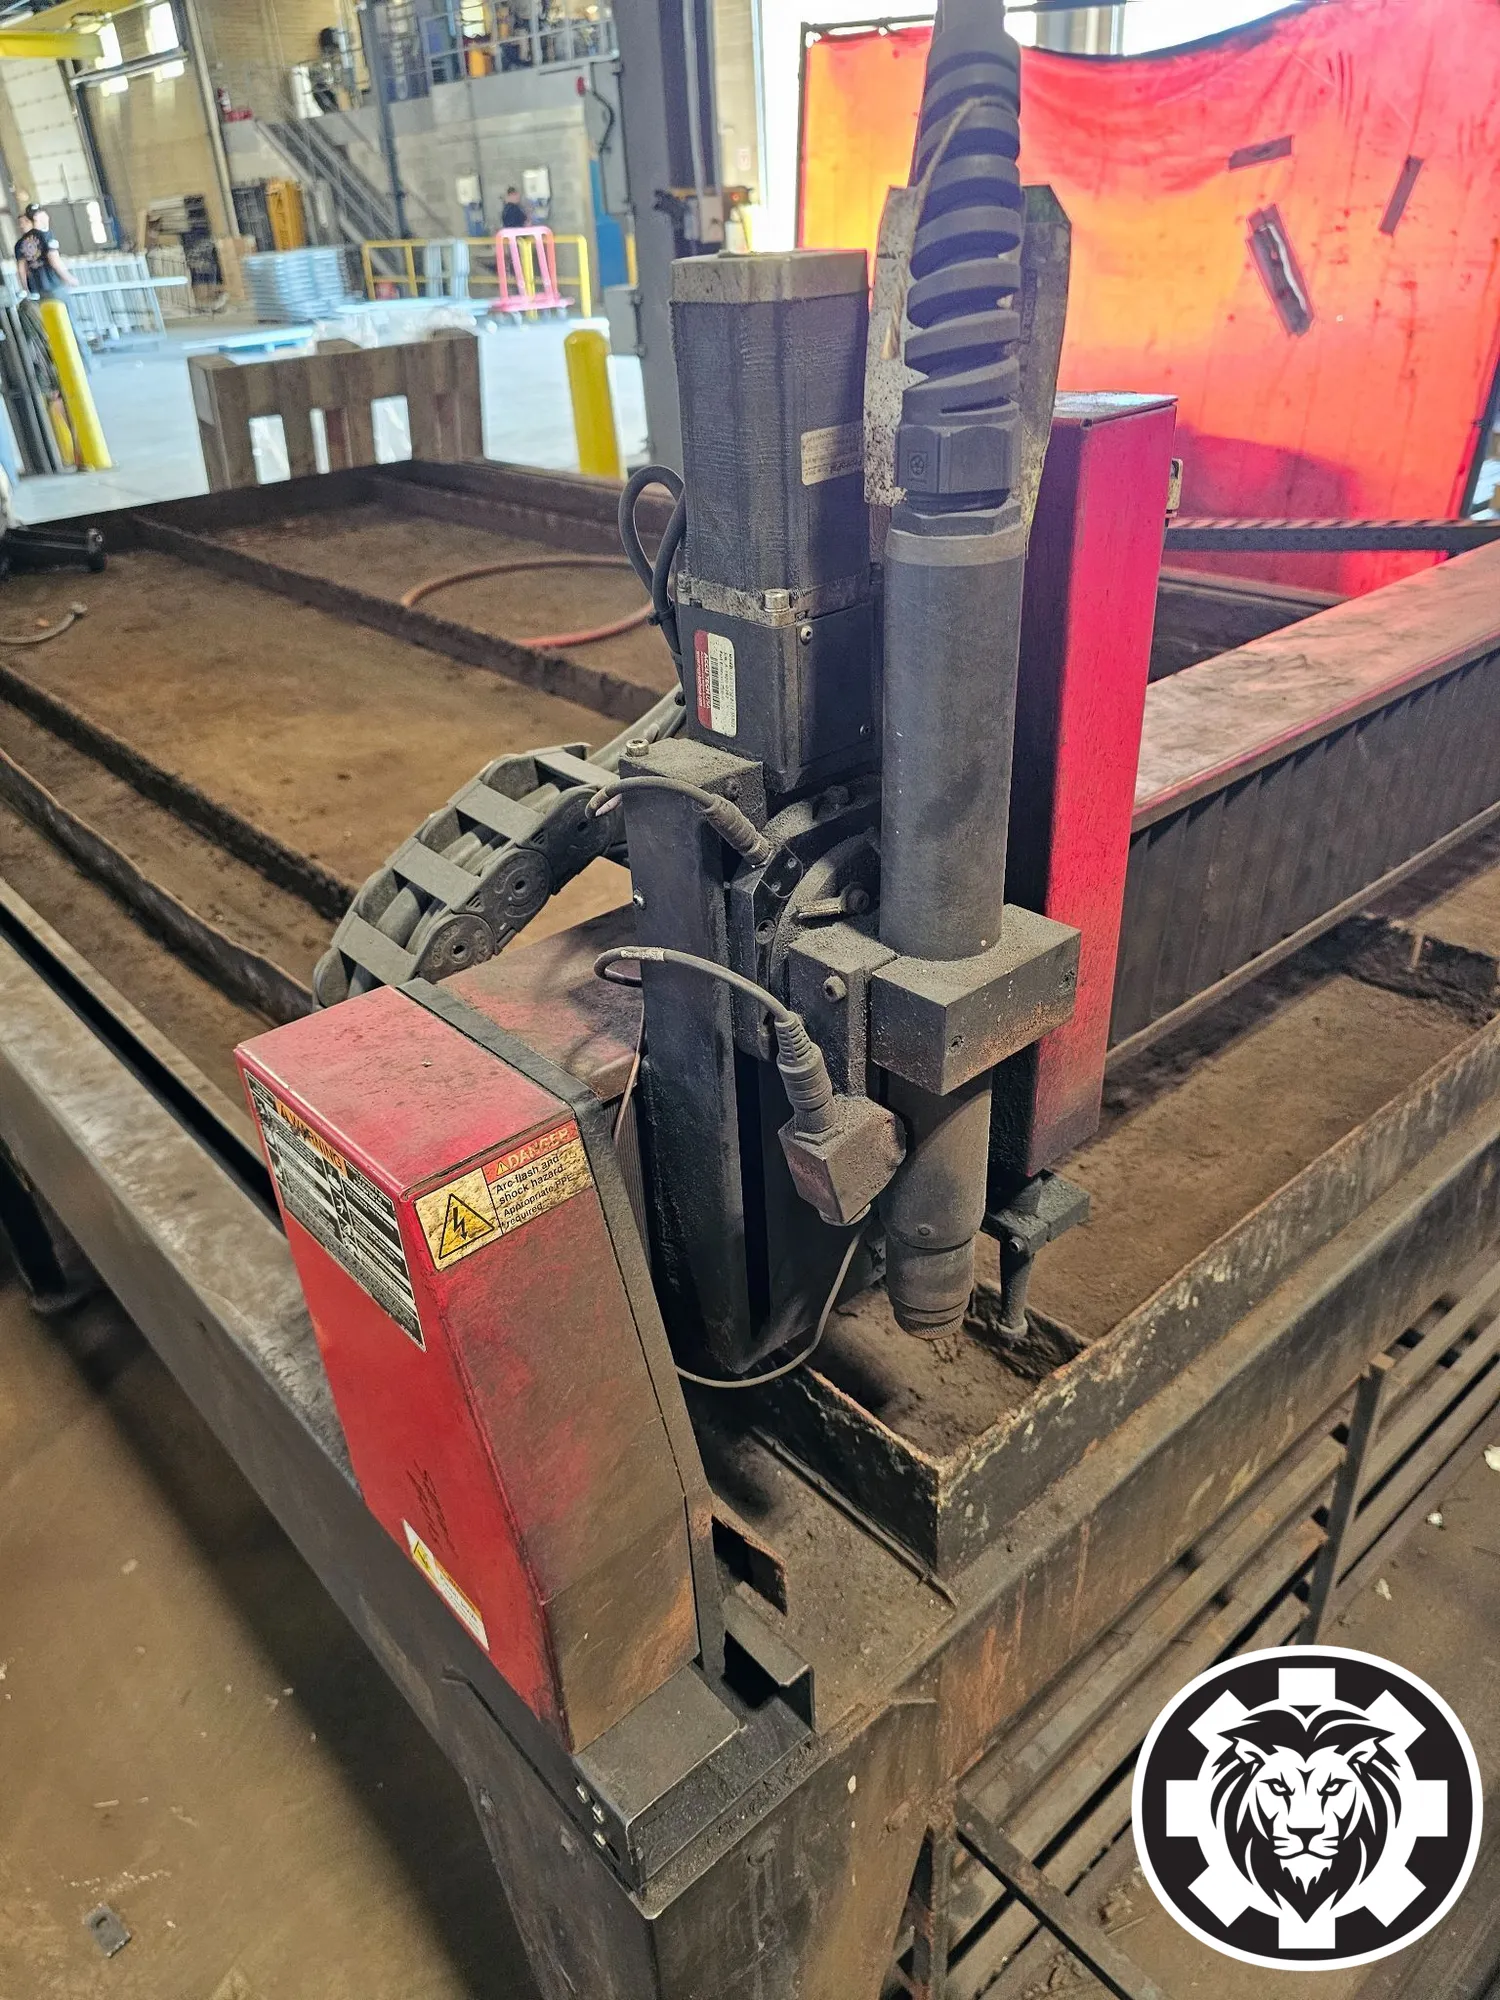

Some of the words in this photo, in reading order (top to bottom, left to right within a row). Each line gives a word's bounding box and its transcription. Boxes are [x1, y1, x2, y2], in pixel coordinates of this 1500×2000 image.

[507, 1128, 568, 1166] DANGER
[496, 1179, 514, 1194] Arc
[515, 1166, 539, 1184] flash
[541, 1153, 559, 1170] and
[499, 1183, 529, 1205] shock
[503, 1186, 554, 1217] Appropriate
[554, 1174, 574, 1189] PPE
